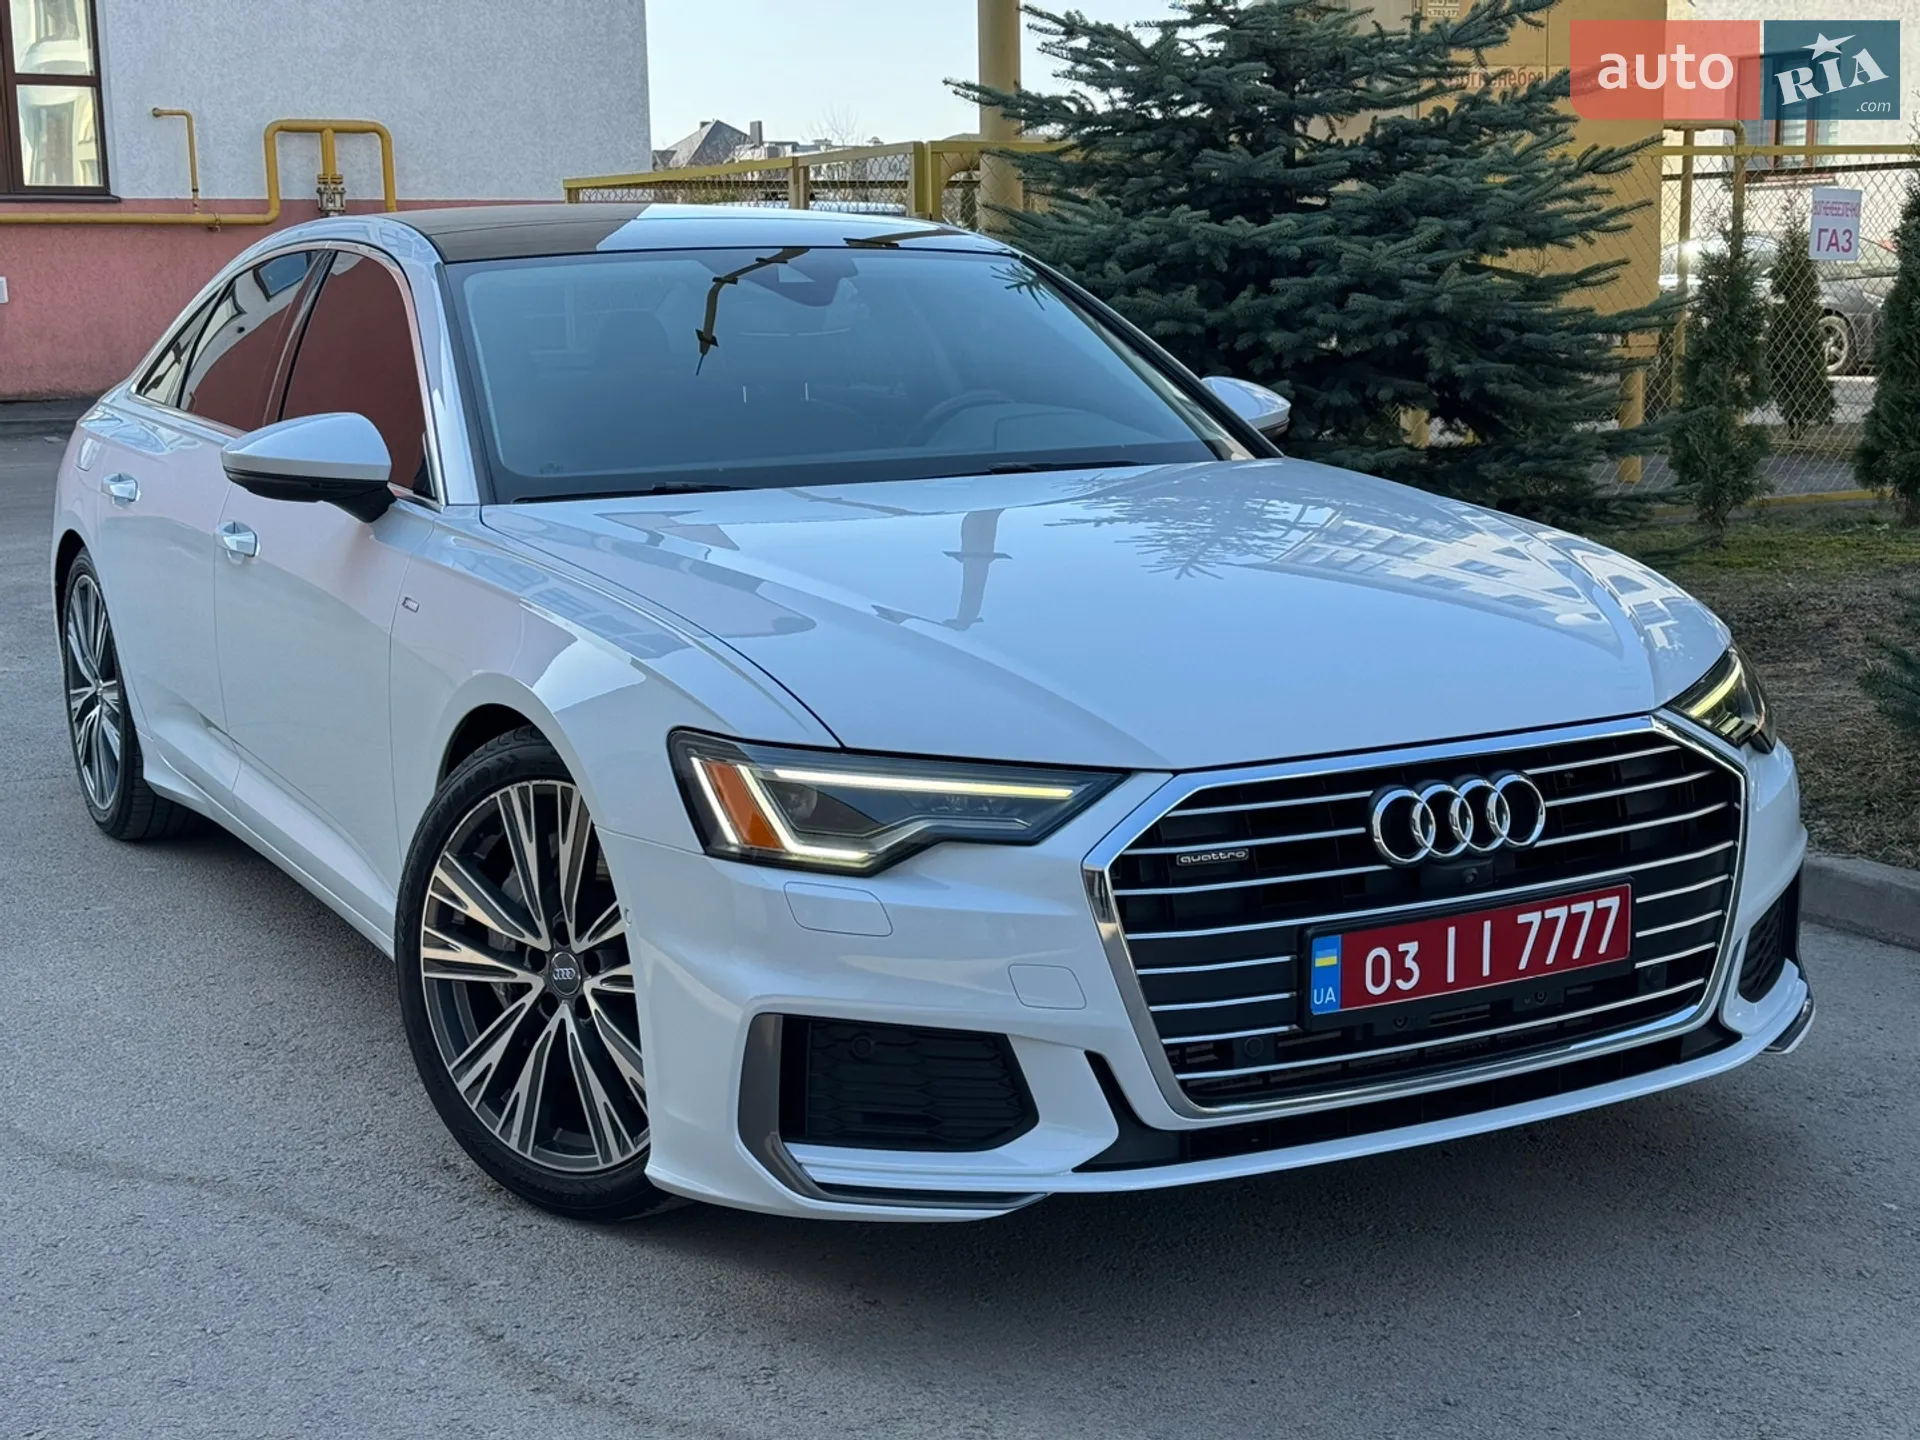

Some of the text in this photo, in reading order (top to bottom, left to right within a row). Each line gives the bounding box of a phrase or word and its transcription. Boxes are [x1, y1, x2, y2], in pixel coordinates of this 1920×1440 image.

[1816, 228, 1853, 253] ГАЗ
[1180, 850, 1246, 864] quattro
[1365, 941, 1420, 996] 03
[1517, 896, 1620, 970] 7777
[1313, 987, 1336, 1005] UA
